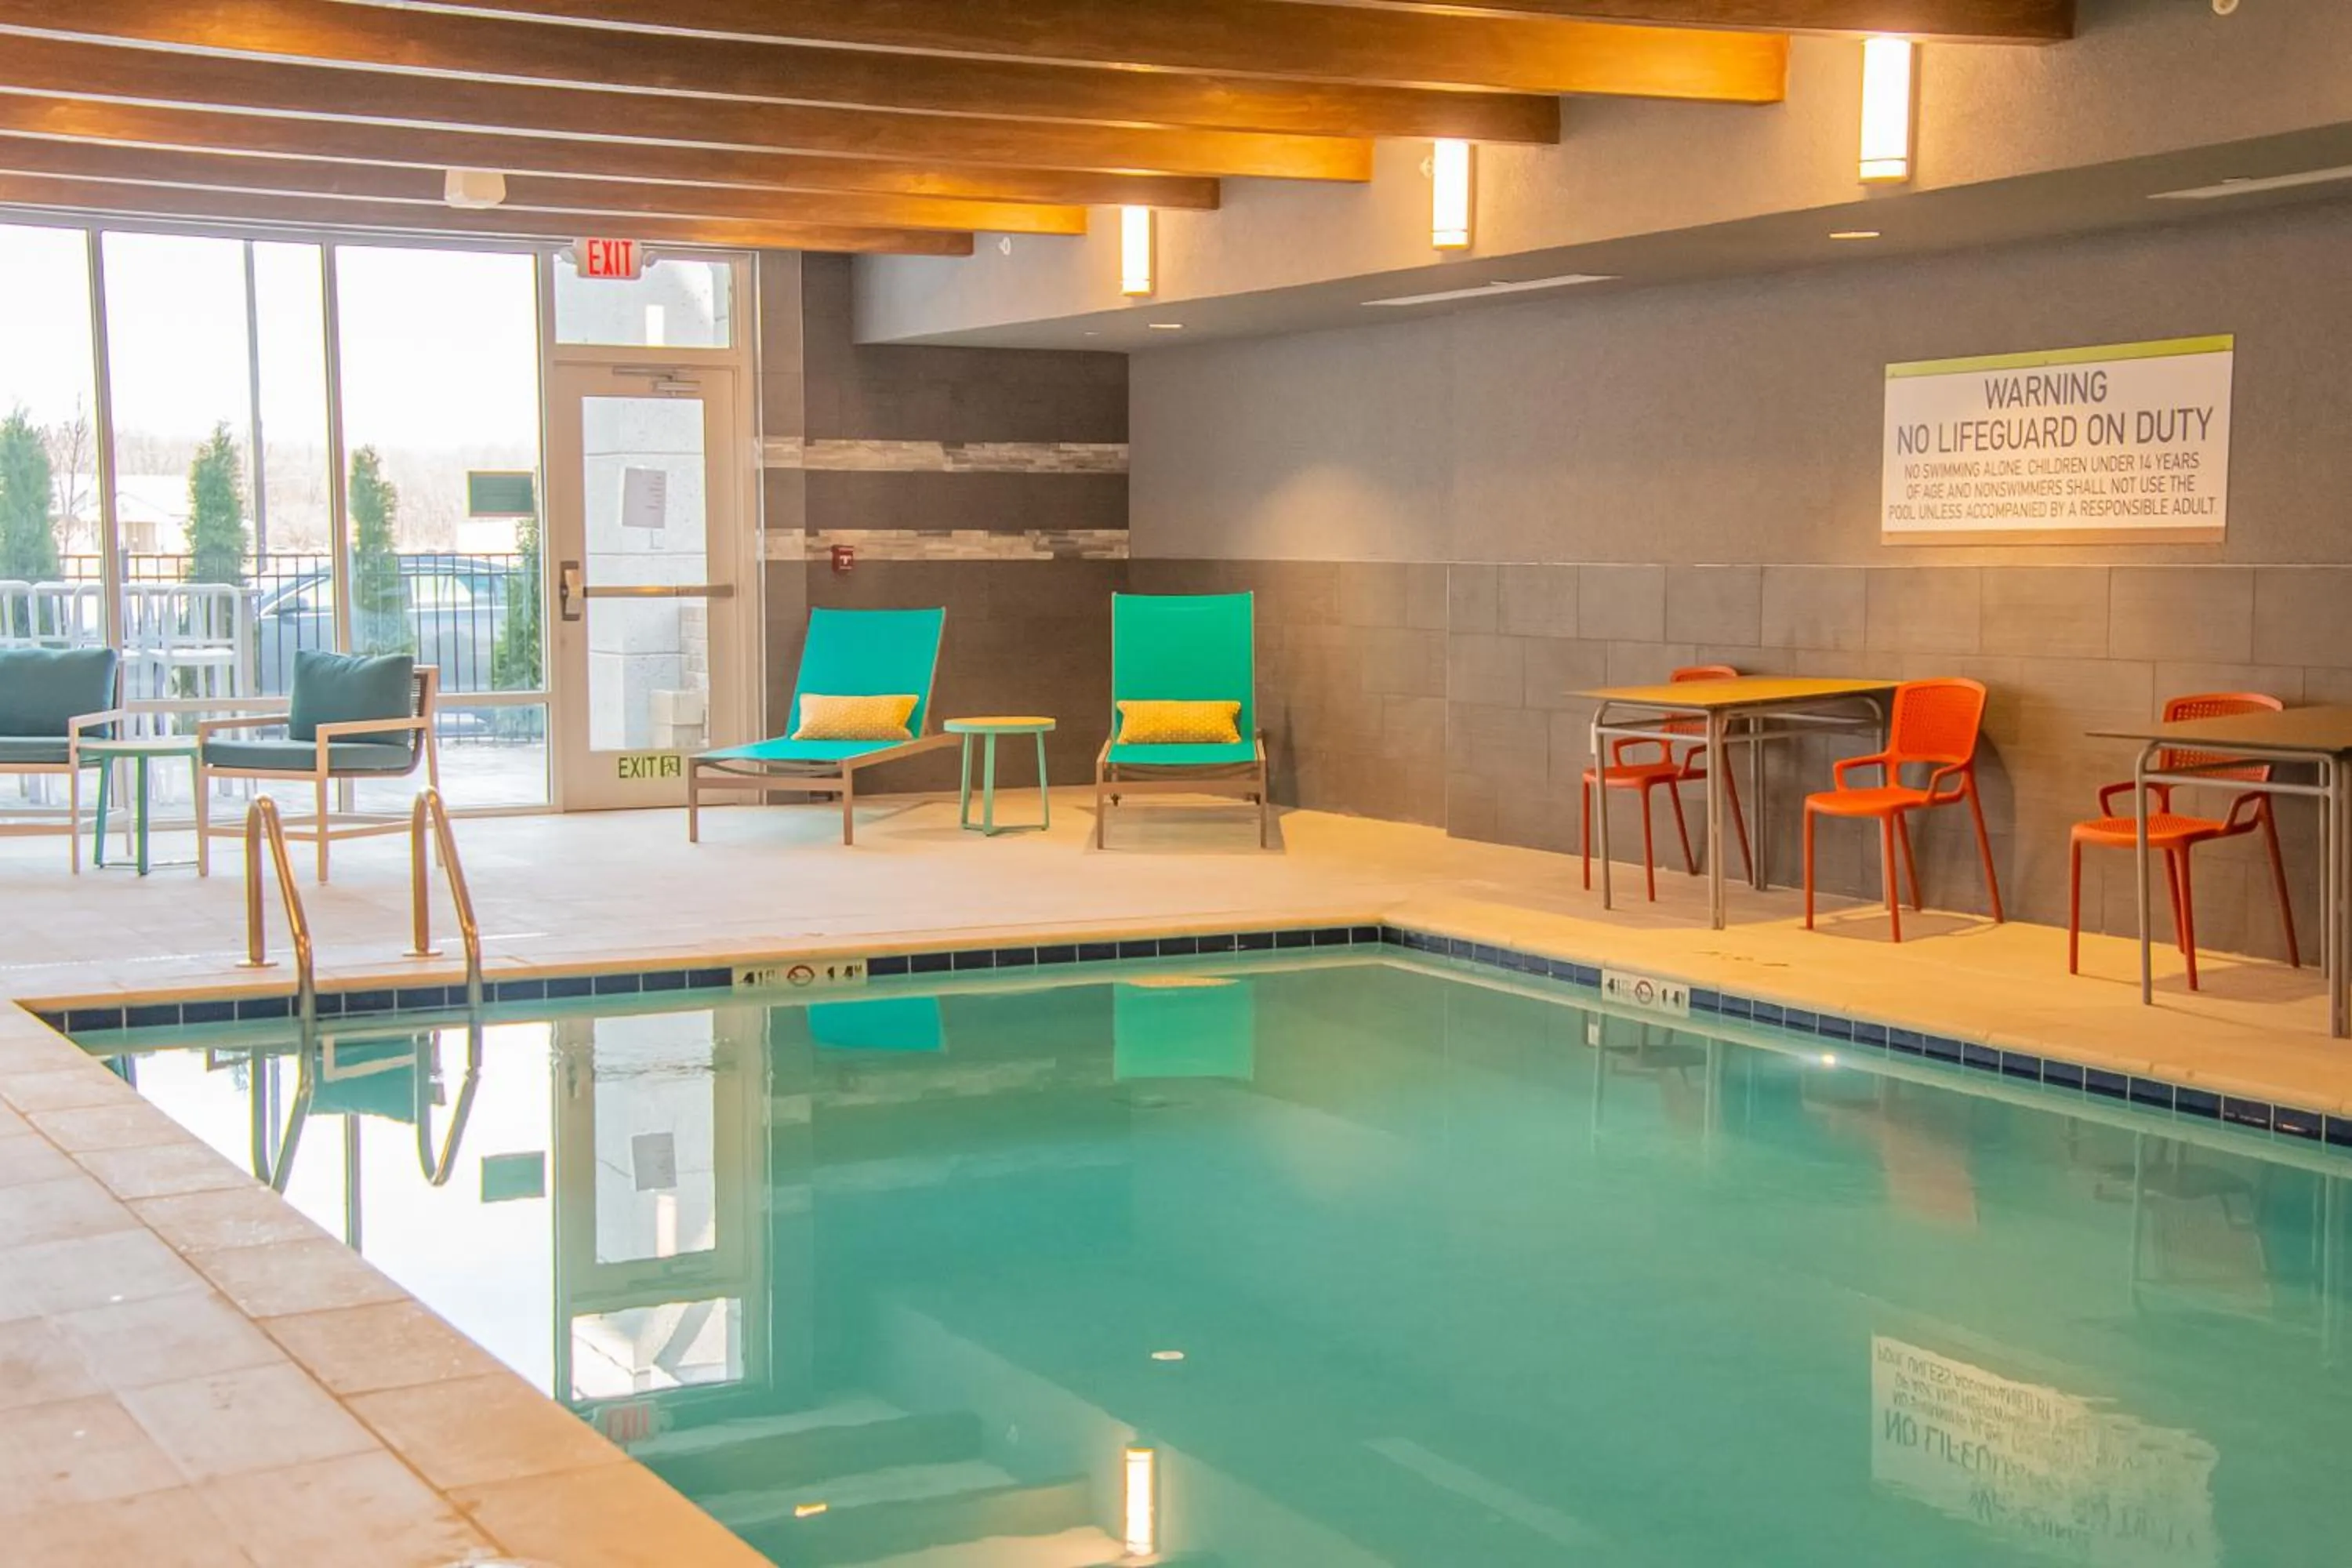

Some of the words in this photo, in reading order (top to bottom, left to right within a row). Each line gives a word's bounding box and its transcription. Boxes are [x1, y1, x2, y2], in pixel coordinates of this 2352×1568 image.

[588, 239, 633, 276] EXIT
[1984, 370, 2107, 410] WARNING
[1897, 423, 1930, 456] NO
[1938, 416, 2077, 452] LIFEGUARD
[2087, 412, 2125, 446] ON
[2136, 406, 2213, 444] DUTY
[1904, 463, 1920, 480] NO
[1923, 461, 1980, 479] SWIMMING
[2027, 456, 2087, 475] CHILDREN
[2091, 454, 2135, 473] UNDER
[2140, 454, 2152, 470] 14
[2156, 452, 2200, 470] YEARS
[1906, 483, 1921, 499] OF
[1923, 482, 1944, 499] AGE
[1947, 481, 1971, 499] AND
[1974, 479, 2062, 499] NONSWIMMERS
[2066, 477, 2107, 495] SHALL
[2111, 476, 2136, 494] NOT
[2140, 475, 2165, 493] USE
[2170, 474, 2195, 492] THE
[1889, 504, 1916, 521] POOL
[1920, 503, 1962, 520] UNLESS
[1966, 501, 2047, 519] ACCOMPANIED
[2050, 500, 2066, 517] BY
[2068, 500, 2078, 517] A
[2080, 497, 2169, 516] RESPONSIBLE
[619, 756, 657, 779] EXIT
